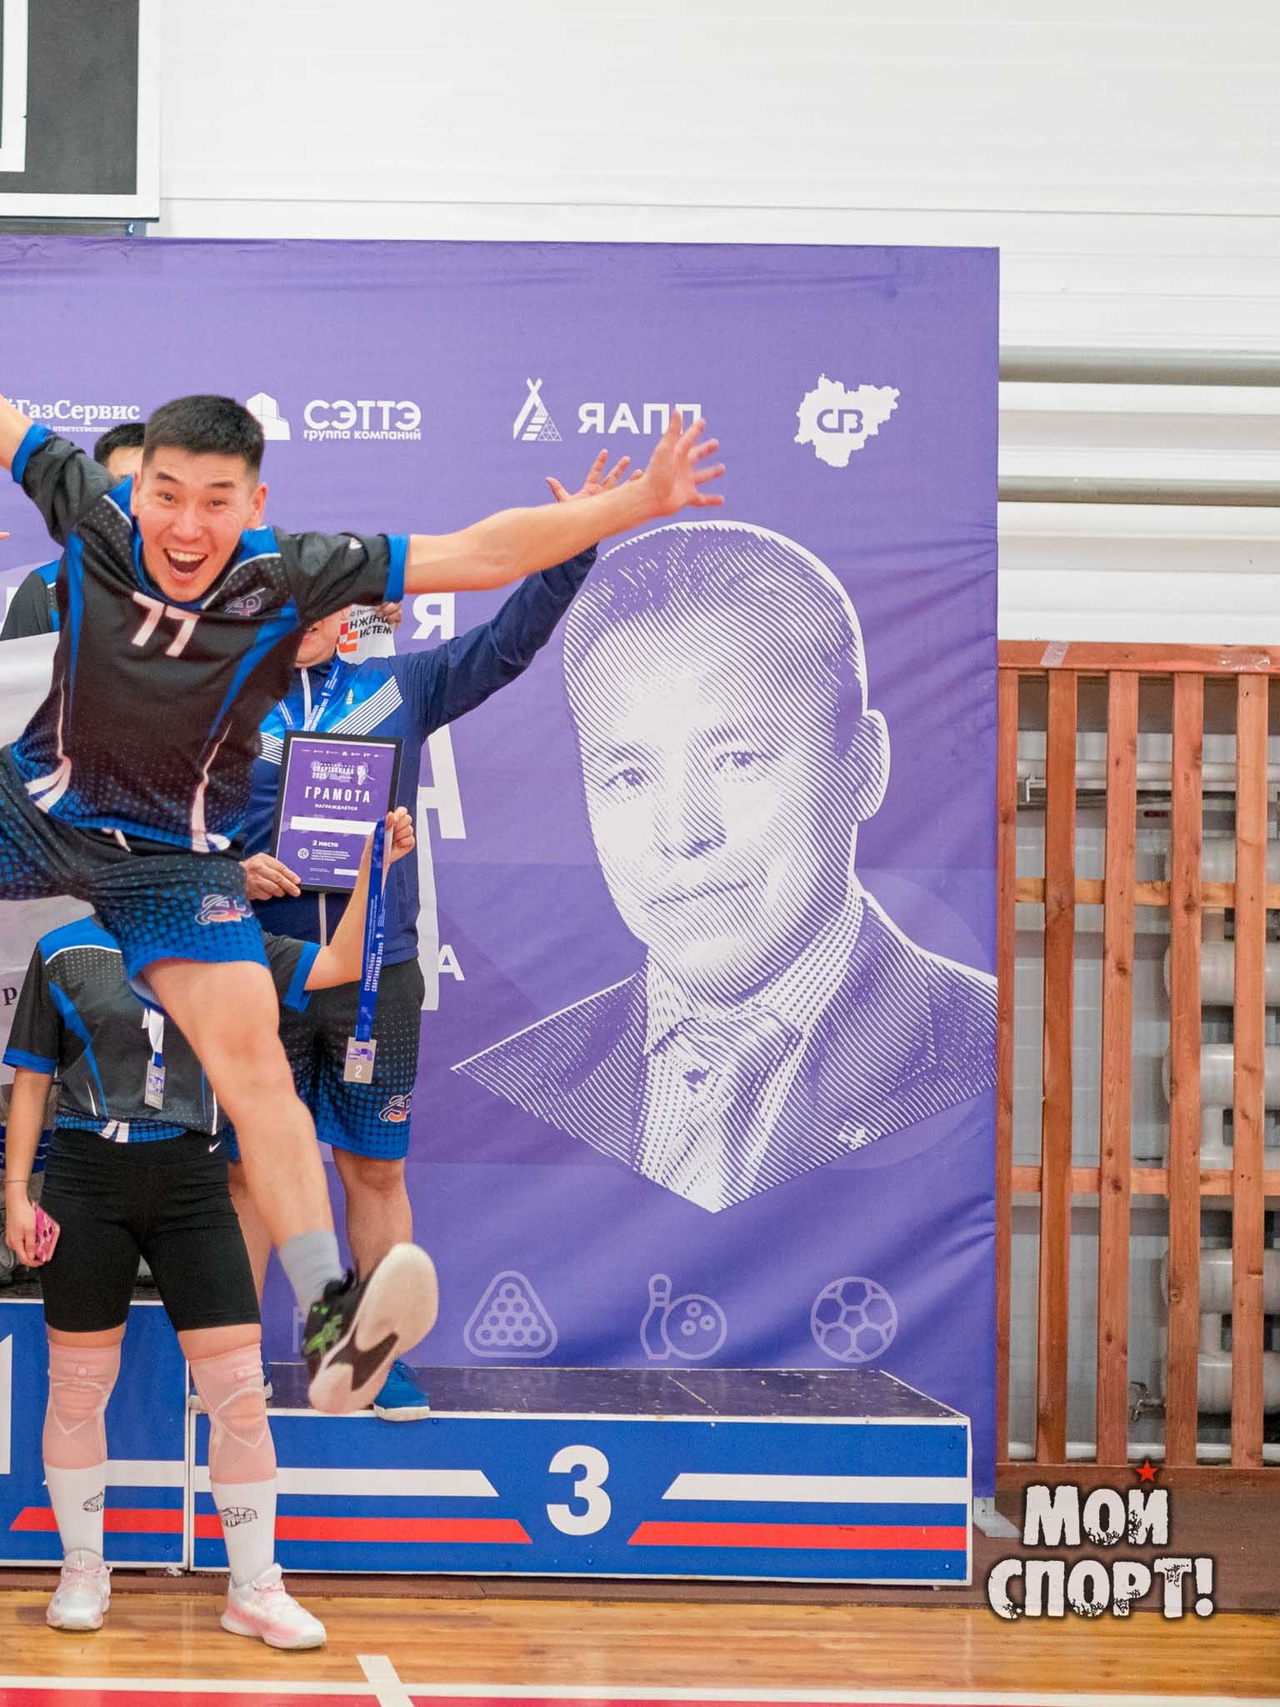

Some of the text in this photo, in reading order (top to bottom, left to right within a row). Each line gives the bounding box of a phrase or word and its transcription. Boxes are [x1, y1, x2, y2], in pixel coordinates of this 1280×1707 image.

[5, 399, 141, 425] ГазСервис
[303, 399, 421, 431] СЭТТЭ
[303, 427, 421, 442] группа компаний
[131, 591, 201, 658] 77
[304, 786, 371, 804] ГРАМОТА
[354, 1064, 363, 1079] 2
[546, 1444, 612, 1537] 3
